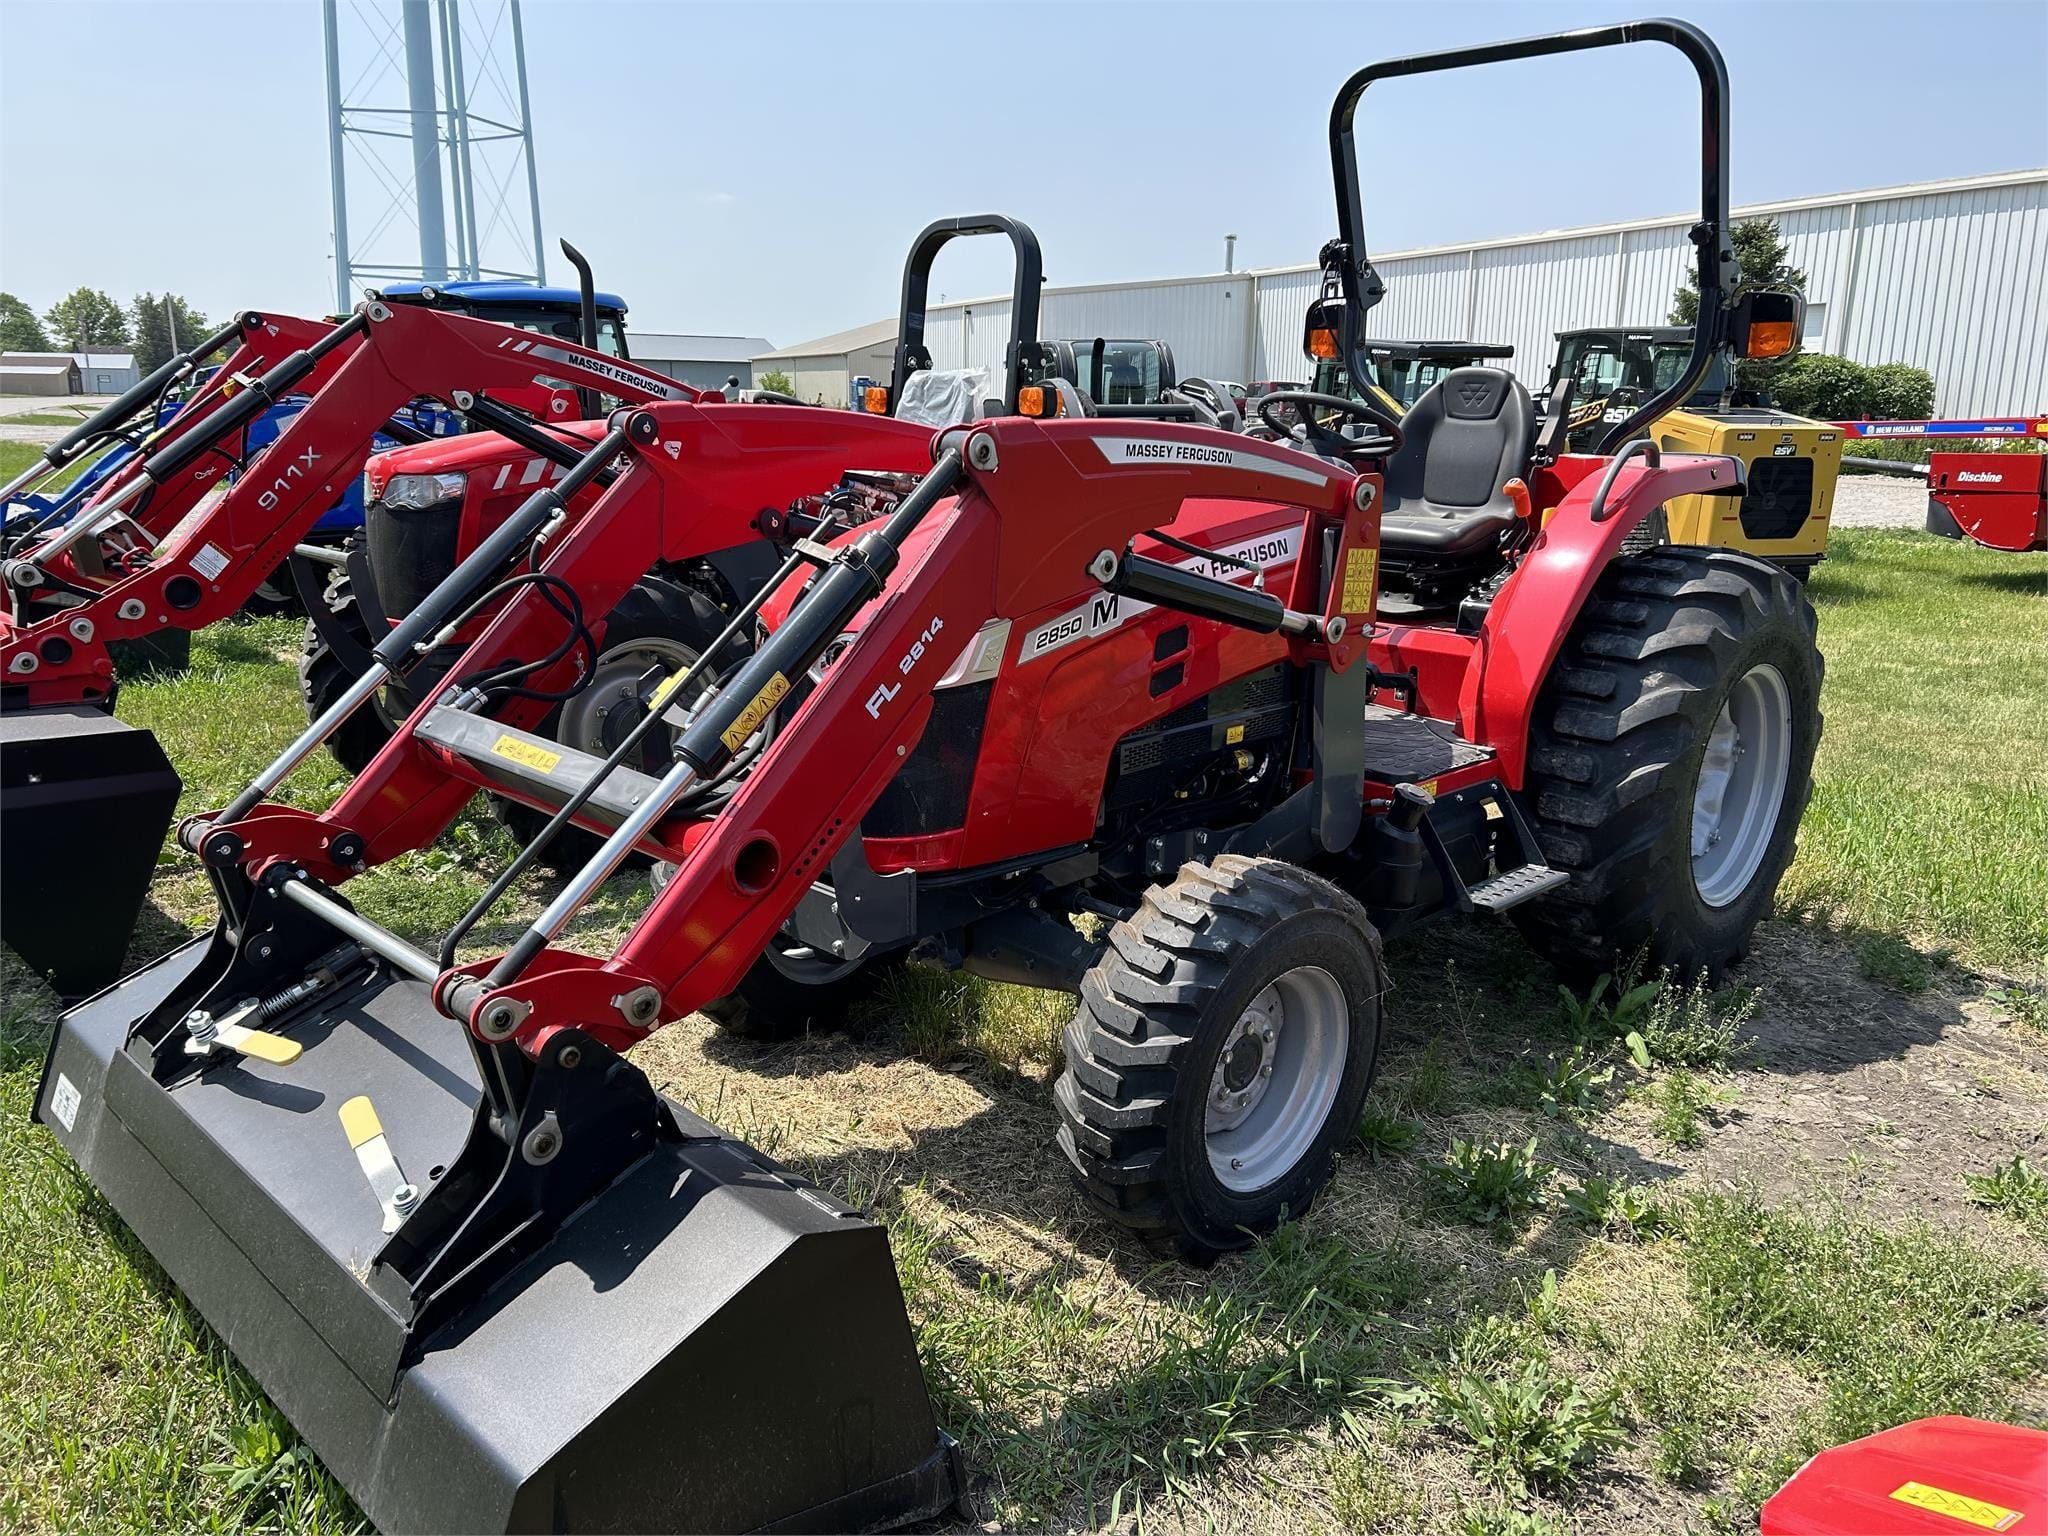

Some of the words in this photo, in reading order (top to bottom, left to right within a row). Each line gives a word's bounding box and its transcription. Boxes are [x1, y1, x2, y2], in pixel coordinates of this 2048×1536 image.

[568, 353, 613, 377] MASSEY
[614, 369, 668, 398] FERGUSON
[1875, 426, 1892, 434] NEW
[1892, 425, 1925, 433] HOLLAND
[1126, 444, 1173, 458] MASSEY
[1176, 446, 1233, 464] FERGUSON
[1774, 446, 1795, 455] asv
[258, 445, 322, 511] 911X
[1957, 471, 2003, 483] Discbine
[1035, 616, 1082, 650] 2850
[1092, 594, 1119, 628] M
[865, 682, 902, 719] FL
[899, 616, 944, 675] 2814
